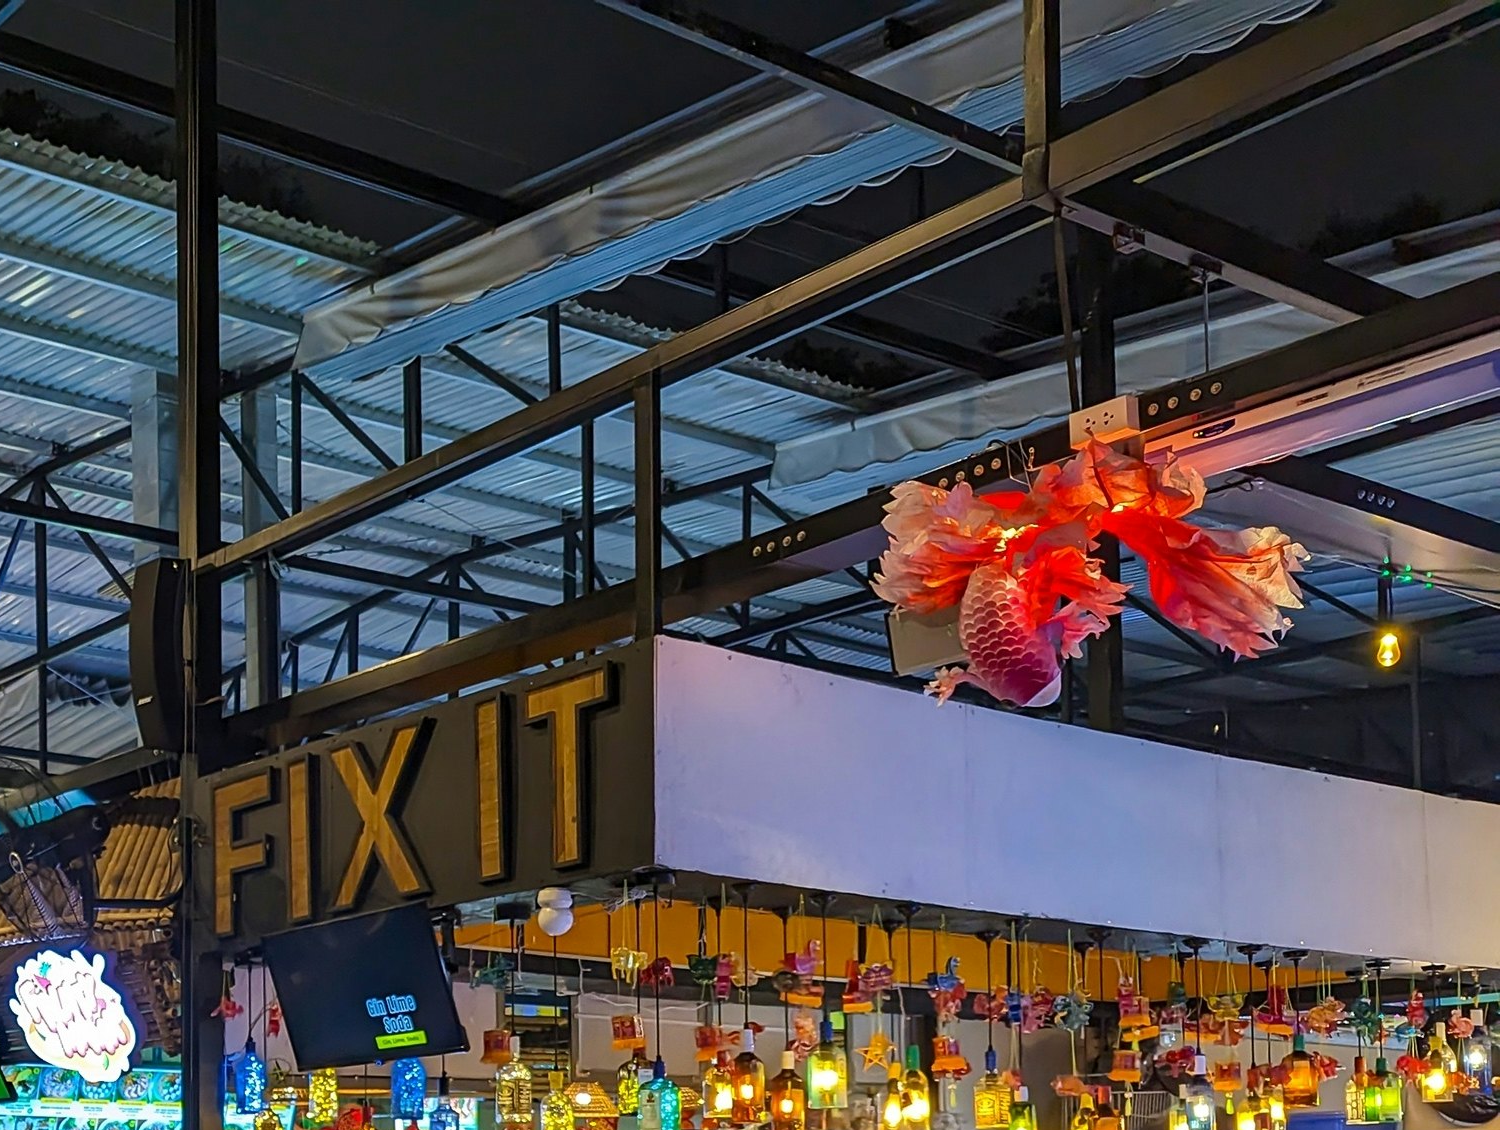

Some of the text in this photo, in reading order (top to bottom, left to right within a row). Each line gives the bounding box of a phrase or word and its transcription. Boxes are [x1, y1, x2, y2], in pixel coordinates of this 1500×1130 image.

[213, 665, 612, 937] FIX IT
[366, 995, 416, 1017] Gin Lime
[383, 1015, 414, 1033] Soda
